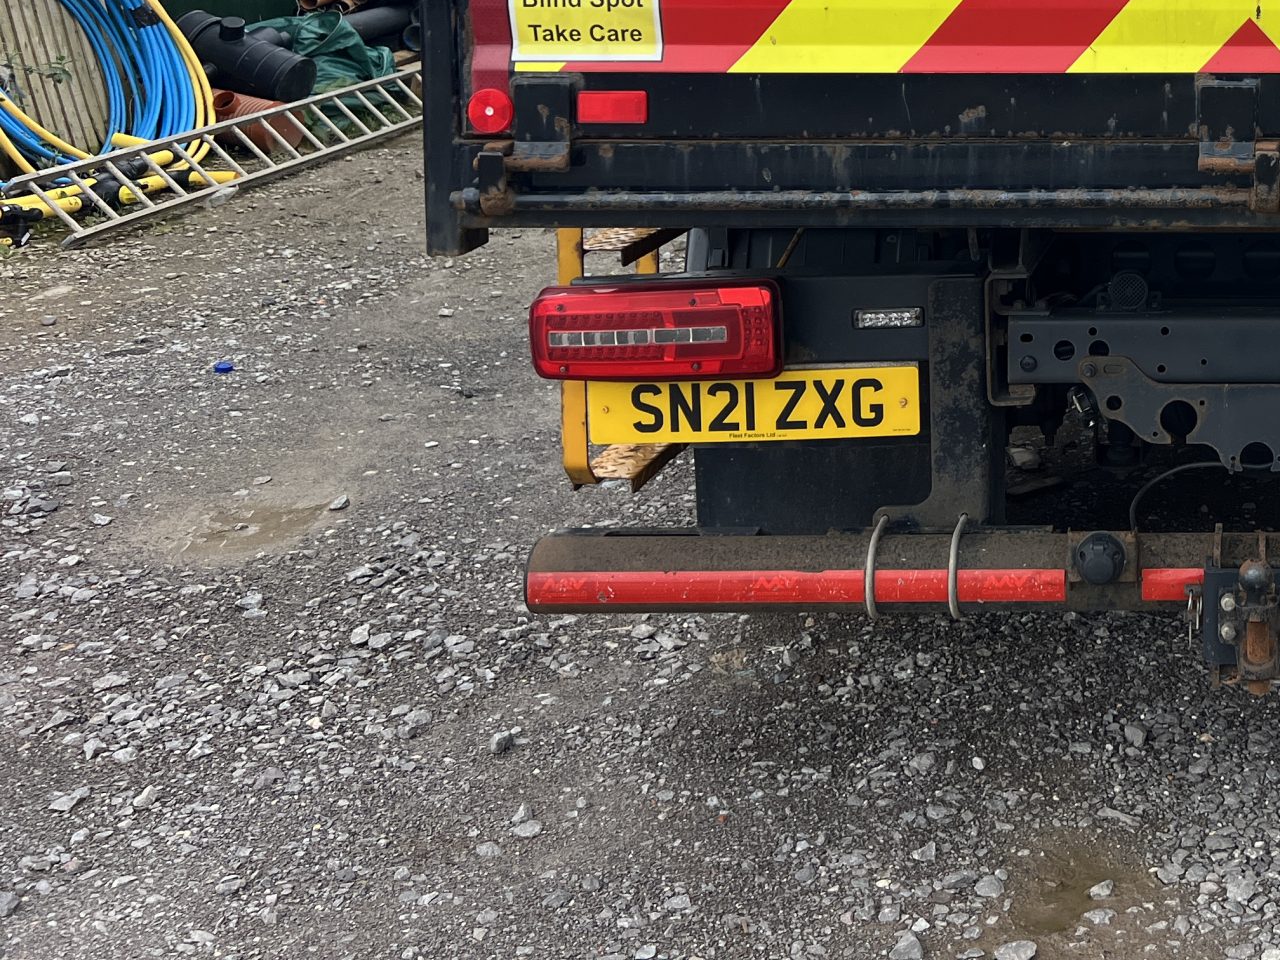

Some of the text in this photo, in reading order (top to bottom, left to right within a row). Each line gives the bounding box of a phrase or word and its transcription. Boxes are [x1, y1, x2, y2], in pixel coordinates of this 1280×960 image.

[528, 24, 643, 42] Take Care
[631, 378, 884, 433] SN21 ZXG
